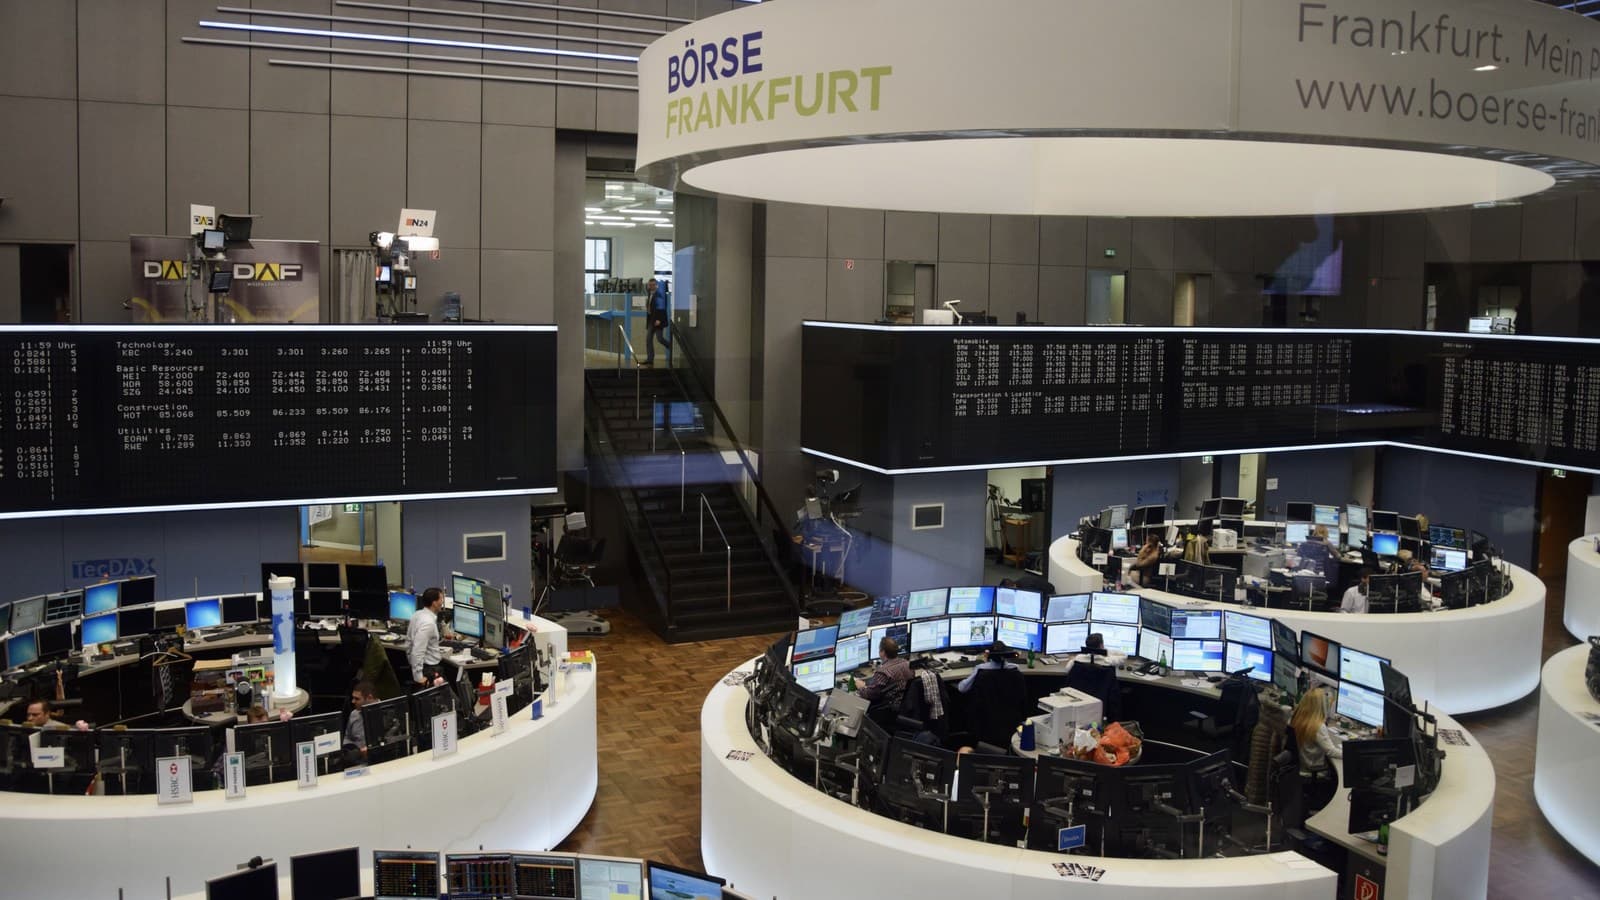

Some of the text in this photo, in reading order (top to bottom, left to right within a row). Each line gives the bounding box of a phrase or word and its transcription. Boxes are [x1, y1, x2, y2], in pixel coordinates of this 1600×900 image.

[1299, 2, 1510, 63] Frankfurt.
[1524, 29, 1583, 78] Mein
[668, 31, 763, 94] BÖRSE
[666, 65, 892, 139] FRANKFURT
[233, 263, 301, 281] DAF
[116, 341, 175, 349] Technology
[152, 364, 204, 372] Resources
[117, 403, 188, 412] Construction
[118, 426, 171, 435] Utilities
